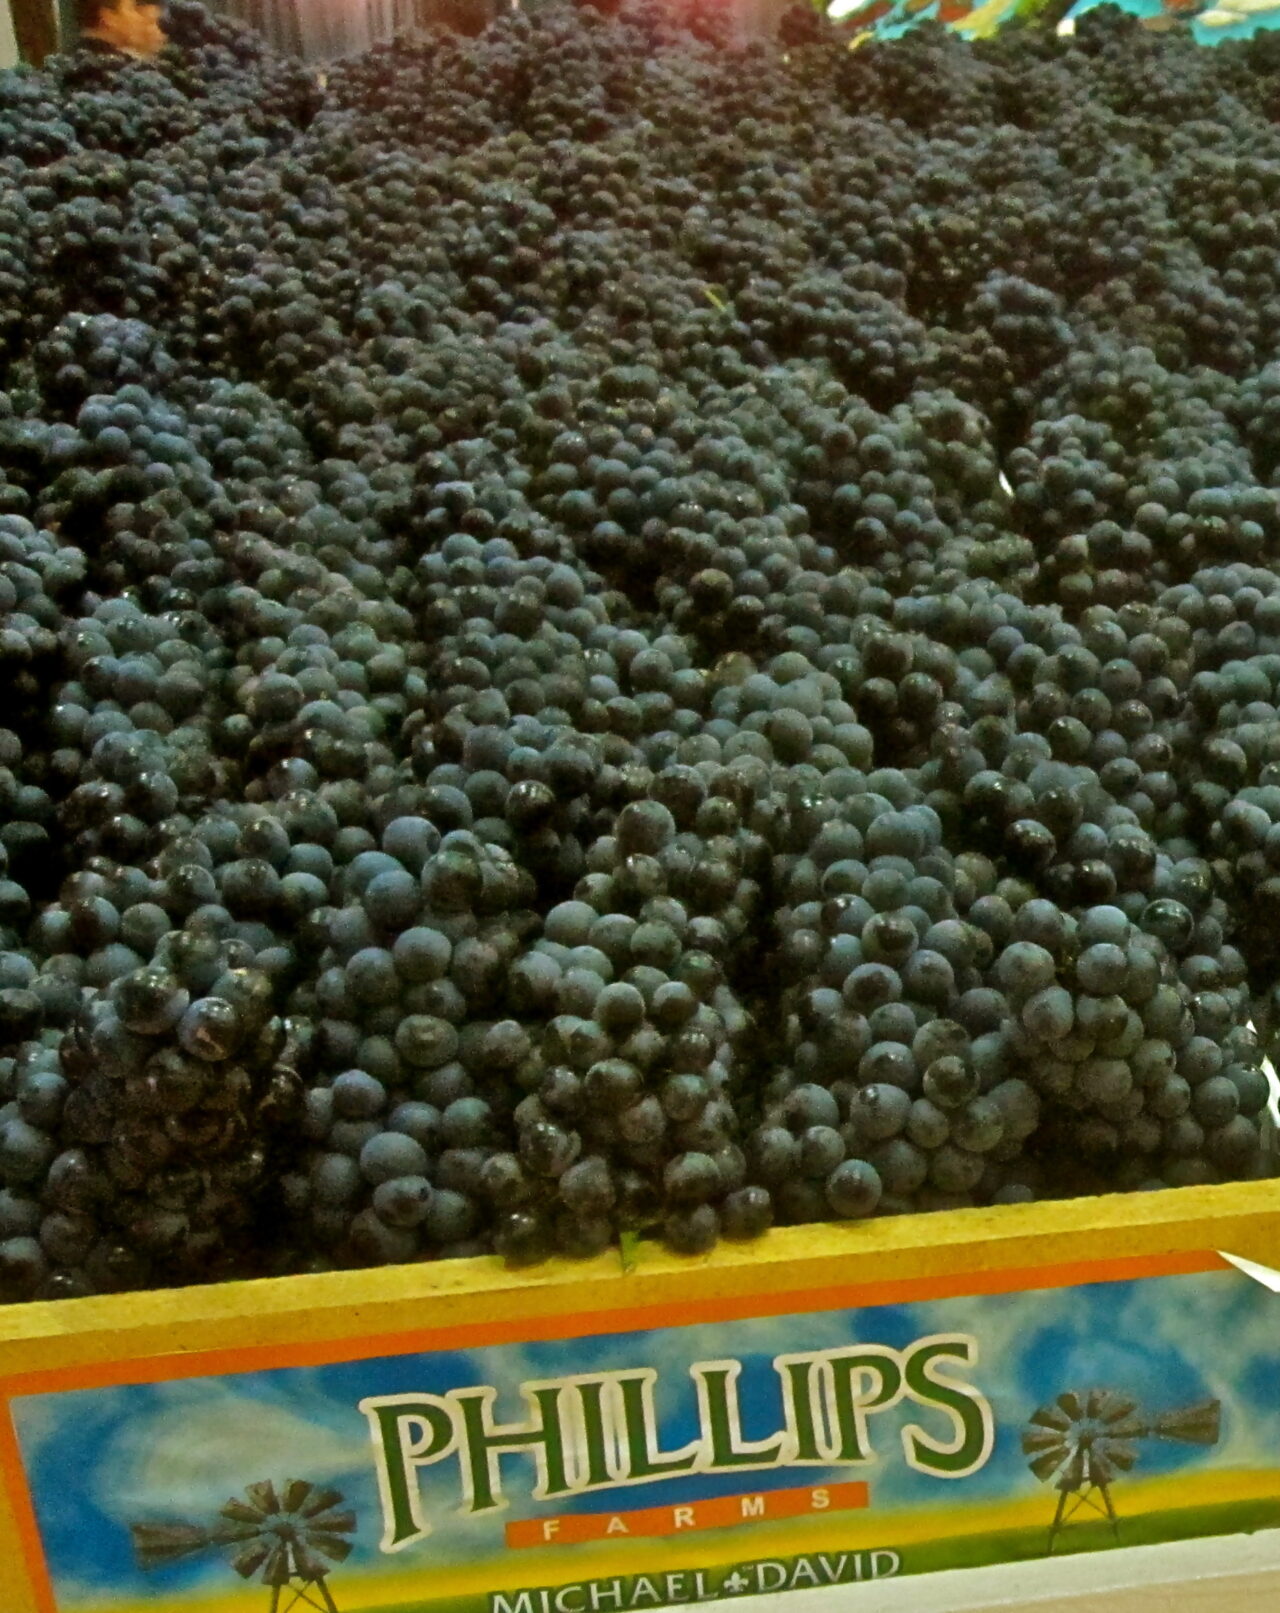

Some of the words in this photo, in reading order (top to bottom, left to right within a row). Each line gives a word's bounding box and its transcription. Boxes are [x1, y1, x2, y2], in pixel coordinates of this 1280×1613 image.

[361, 1334, 994, 1553] PHILLIPS
[543, 1489, 830, 1541] FARMS
[493, 1569, 718, 1613] MICHAEL
[757, 1550, 900, 1592] DAVID
